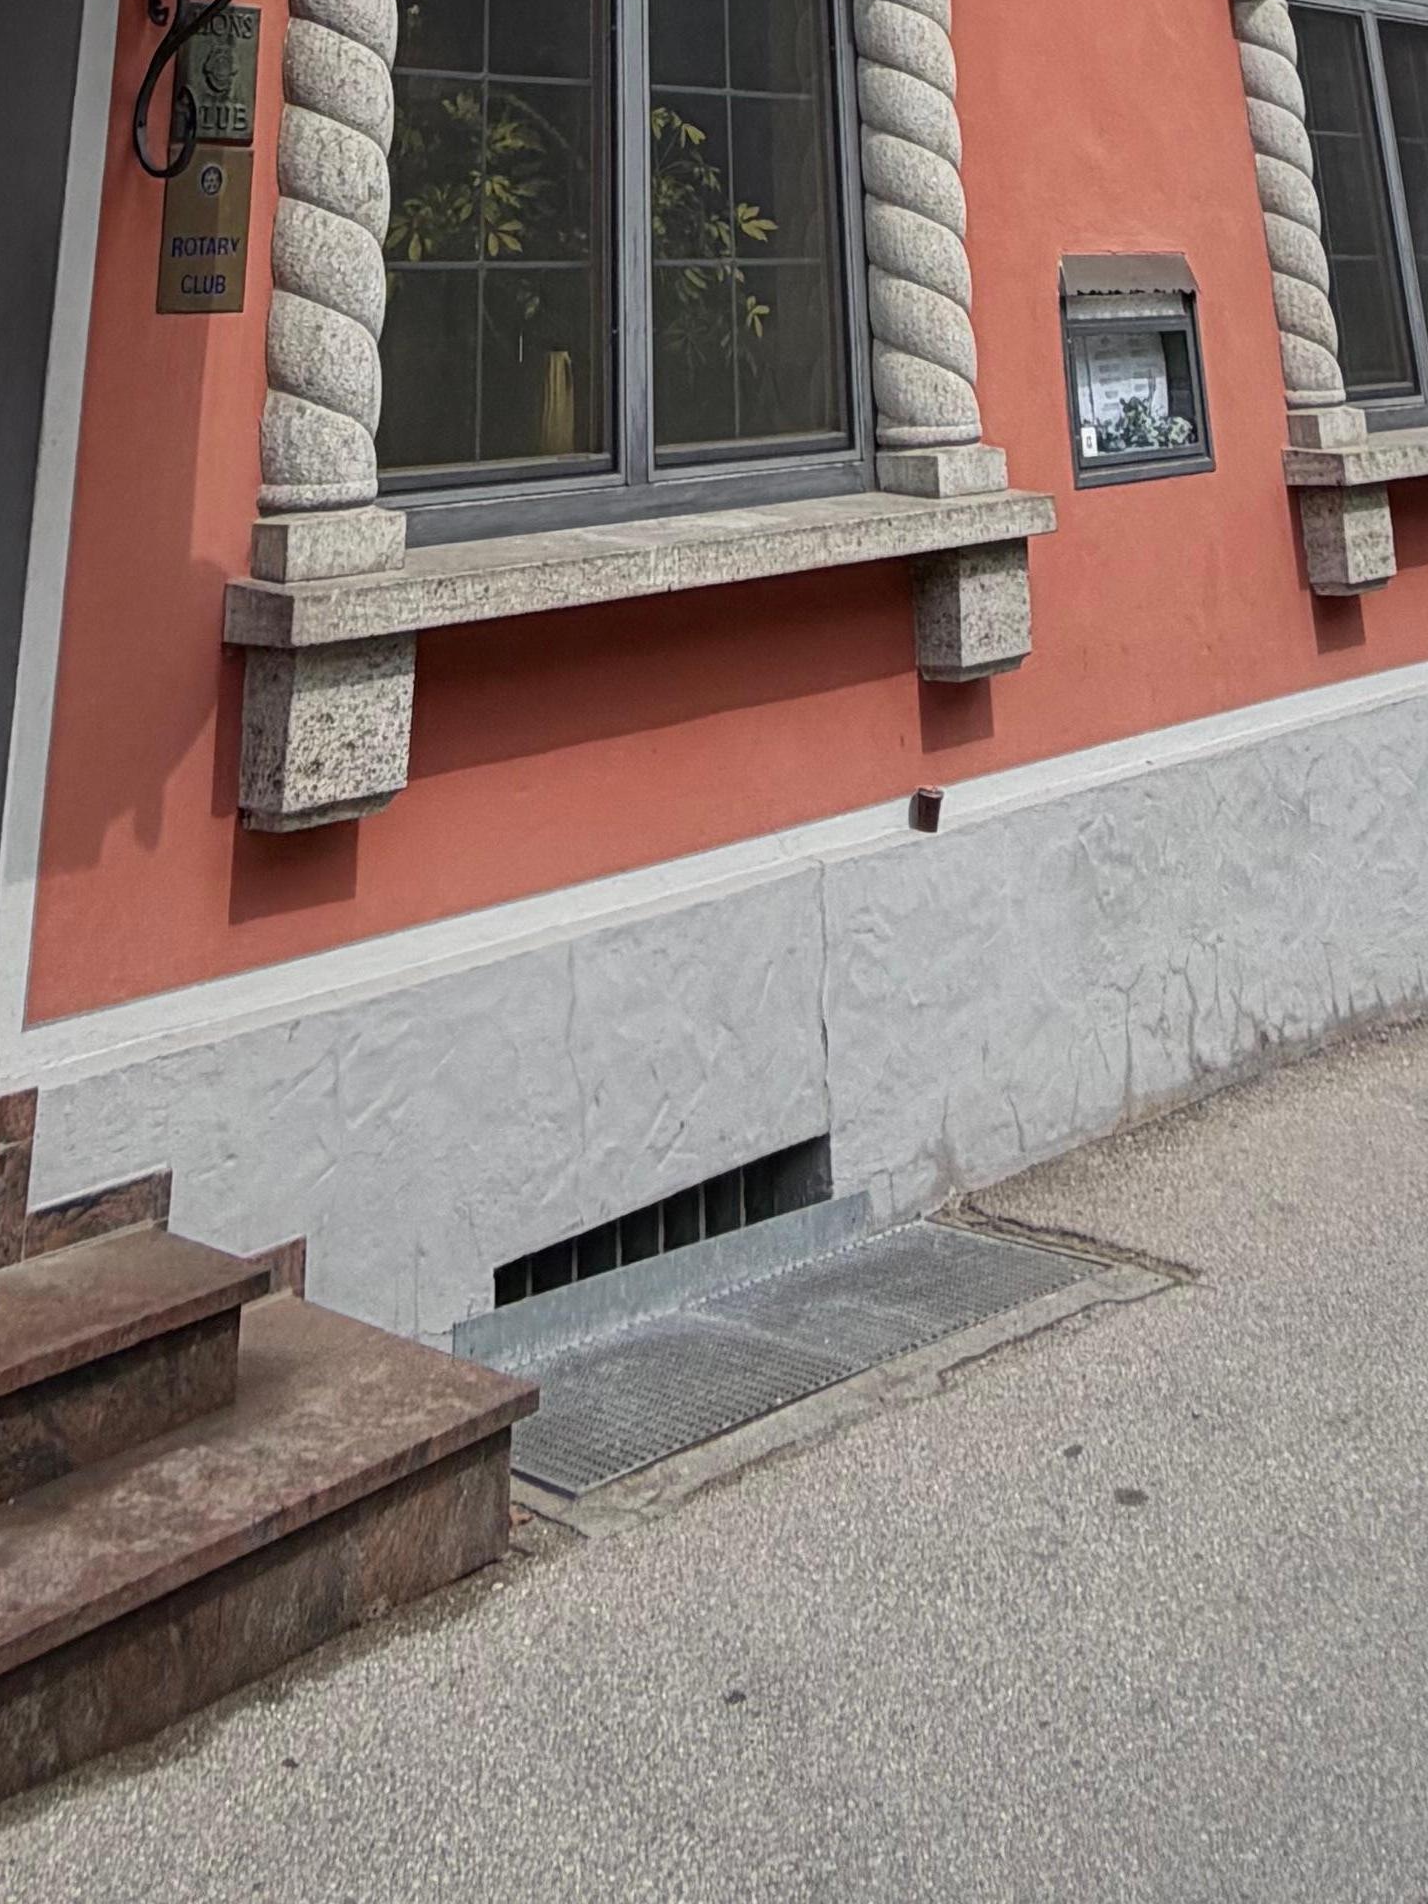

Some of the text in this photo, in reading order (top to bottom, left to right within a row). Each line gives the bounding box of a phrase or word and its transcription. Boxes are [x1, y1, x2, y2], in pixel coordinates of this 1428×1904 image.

[183, 101, 248, 131] LUB
[171, 236, 241, 258] ROTARY
[180, 274, 227, 294] CLUB
